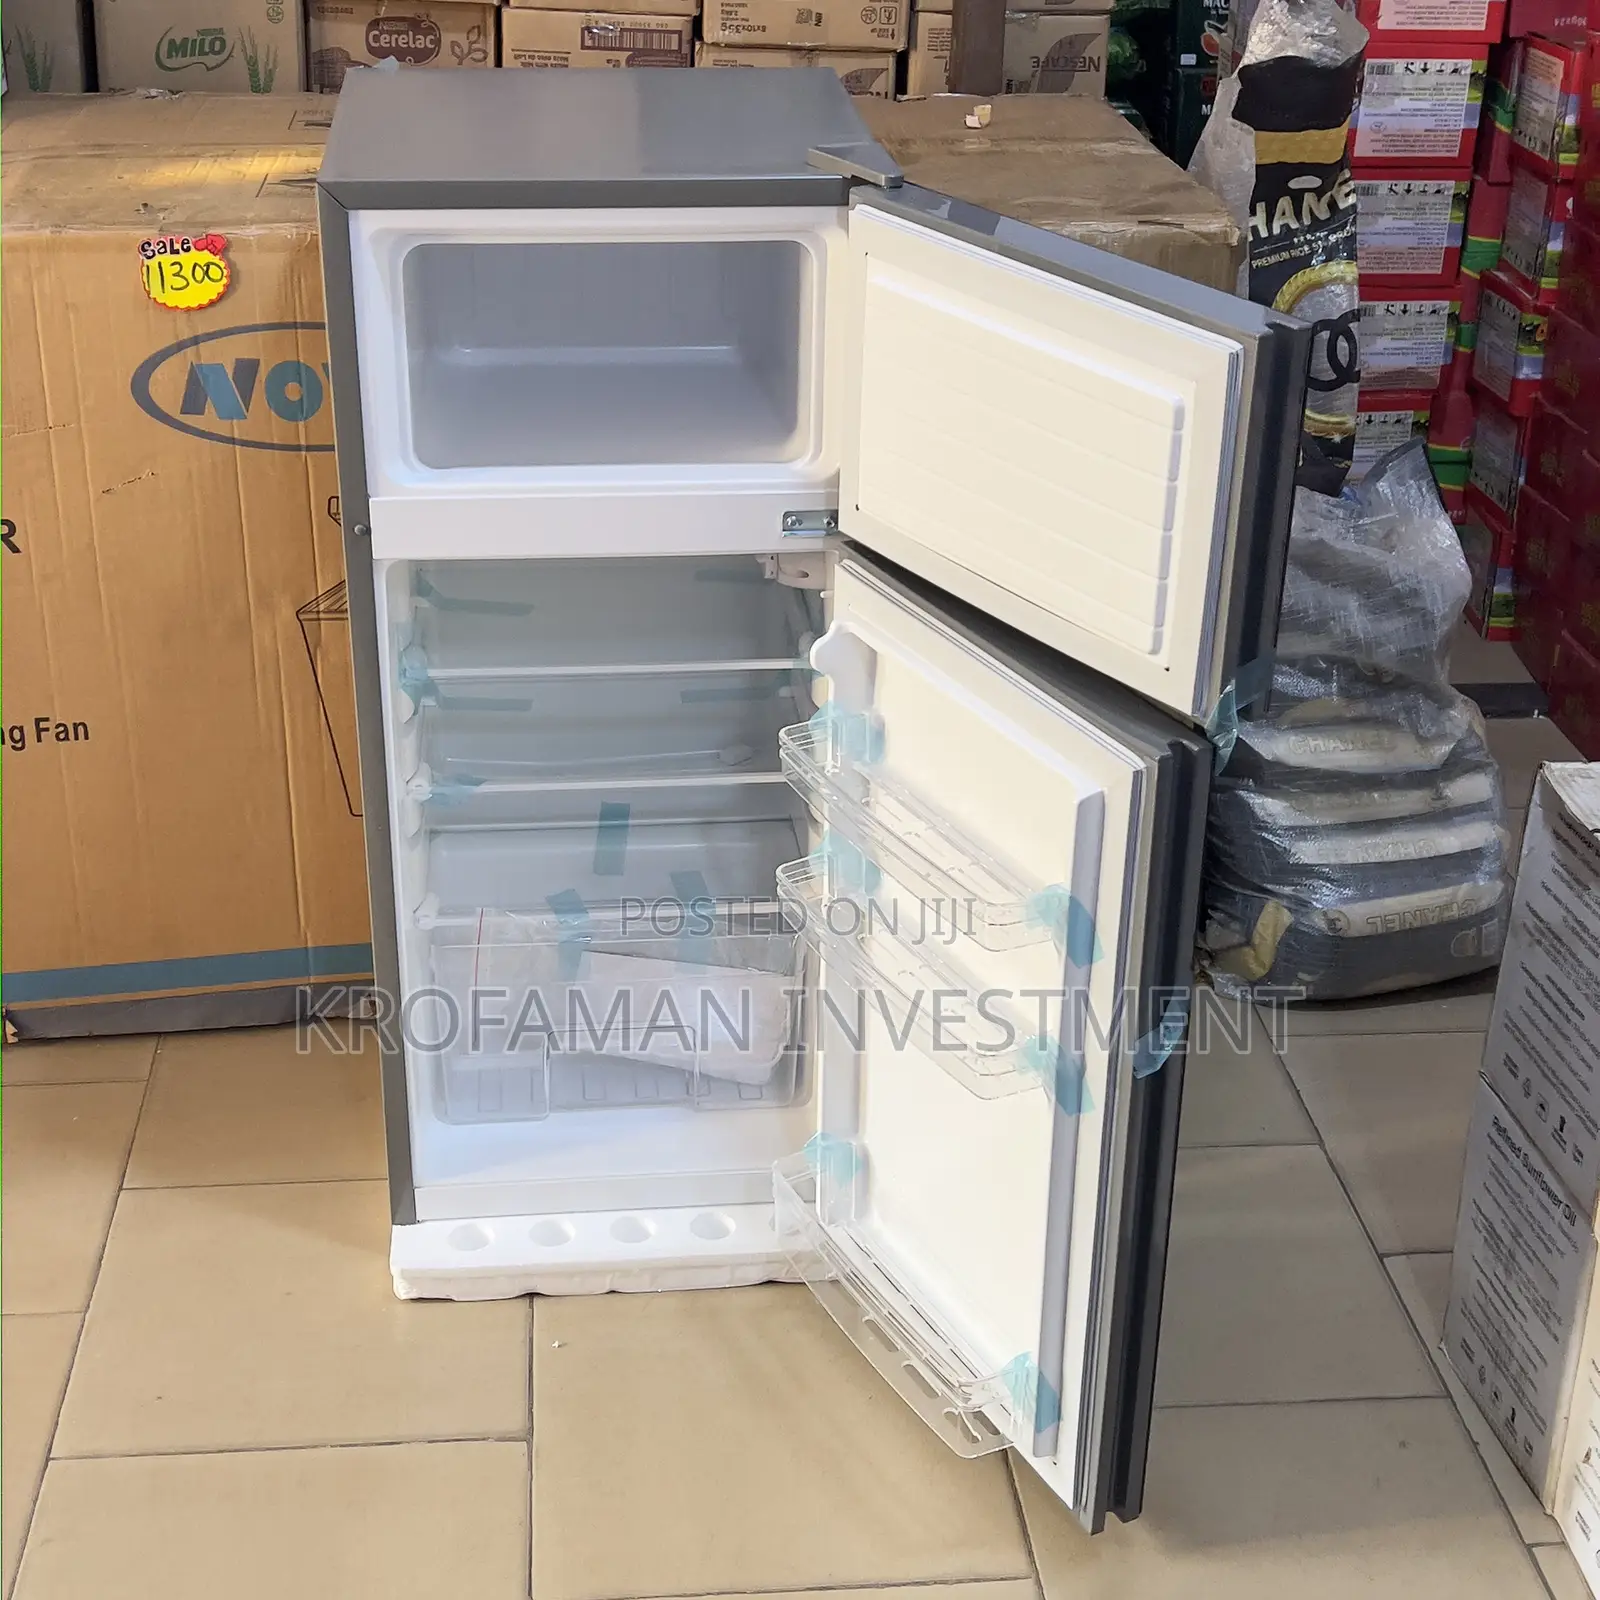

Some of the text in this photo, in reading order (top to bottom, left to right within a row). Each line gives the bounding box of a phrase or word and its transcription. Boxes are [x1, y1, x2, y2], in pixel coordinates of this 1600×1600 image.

[166, 36, 227, 59] MILO
[368, 30, 436, 49] Cerelac
[1251, 243, 1312, 269] PREMIUM RICE
[146, 261, 225, 295] 11300
[180, 357, 331, 424] NO
[34, 716, 90, 743] Fan
[1366, 898, 1478, 936] CHANEL
[1521, 1151, 1564, 1210] Sunflower
[1562, 1202, 1578, 1227] Oil
